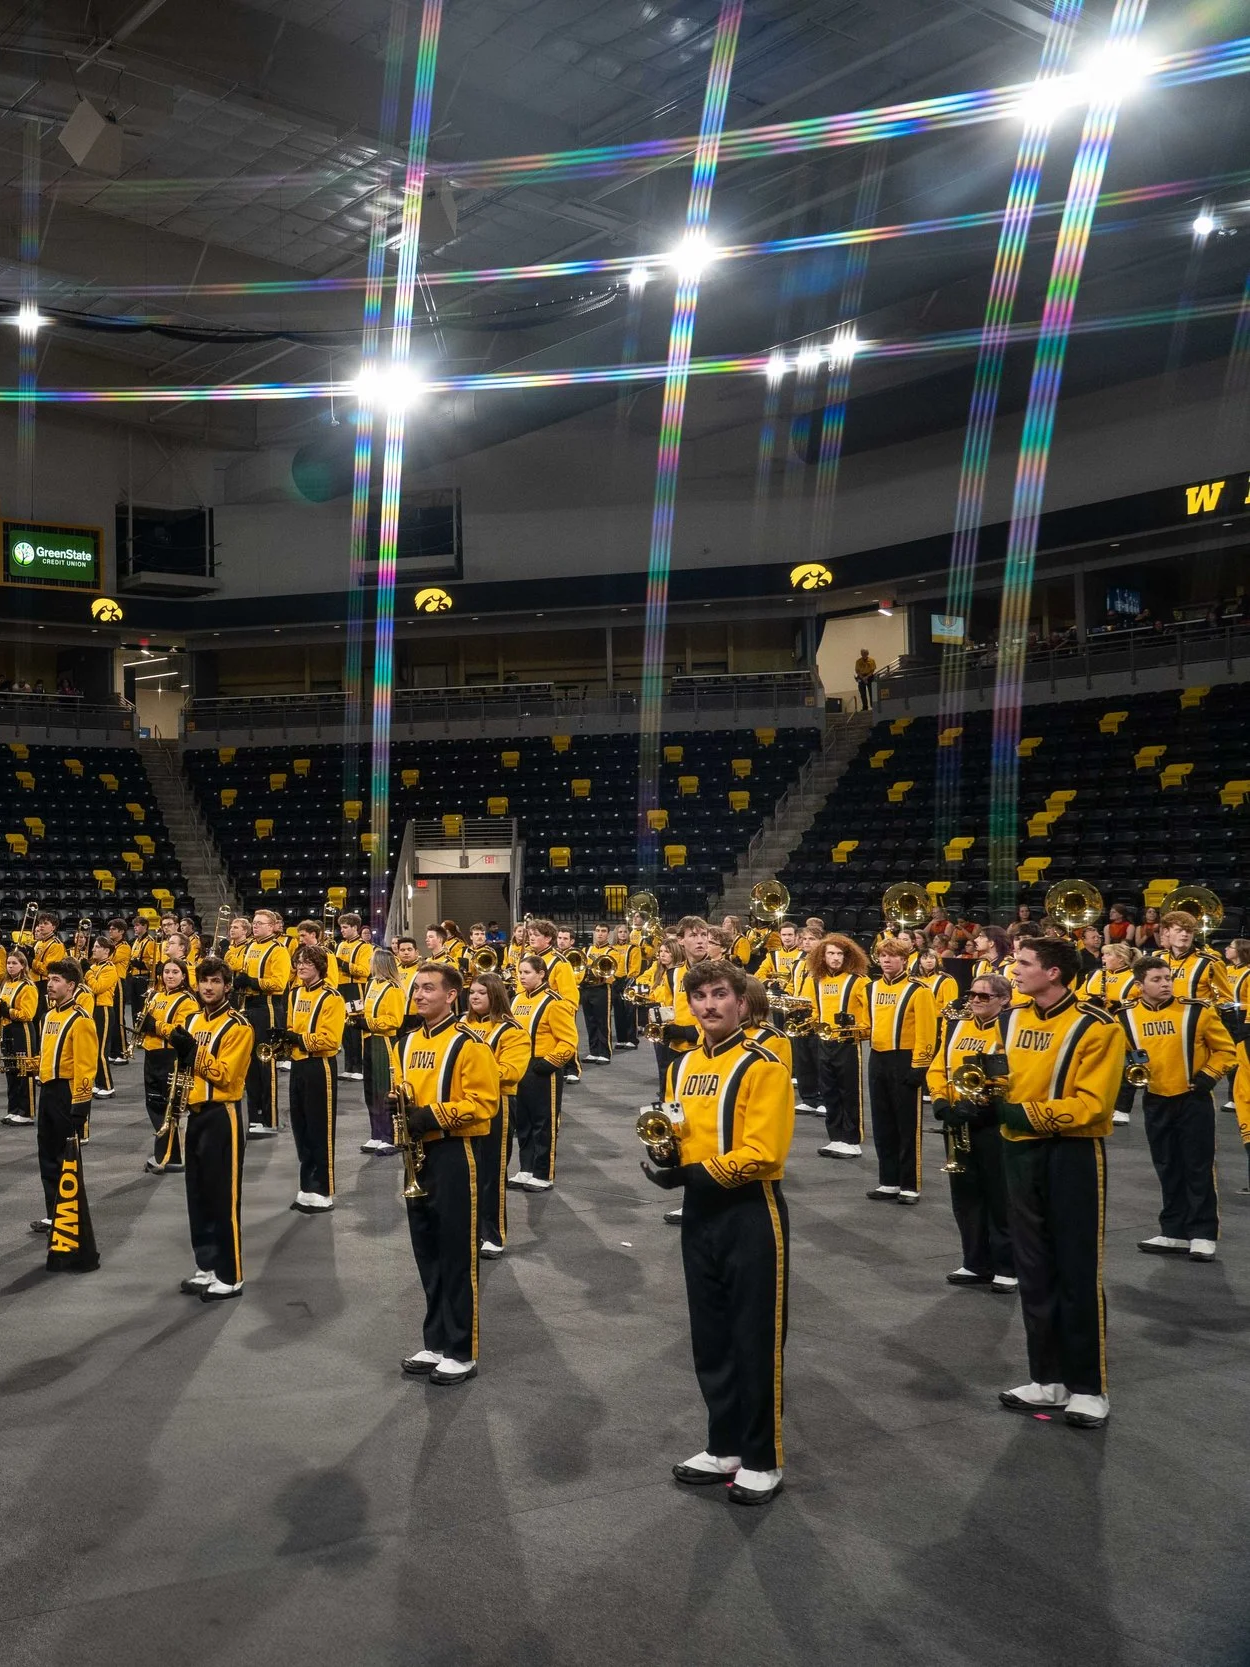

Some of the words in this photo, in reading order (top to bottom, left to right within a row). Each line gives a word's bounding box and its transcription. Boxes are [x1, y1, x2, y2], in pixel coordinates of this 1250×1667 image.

[36, 546, 92, 561] GreenState
[42, 558, 65, 566] CREDIT
[823, 983, 839, 995] IOWA
[876, 992, 897, 1005] IOWA
[1142, 1021, 1176, 1037] IOWA
[955, 1037, 987, 1052] IOWA
[1015, 1029, 1054, 1051] IOW
[409, 1051, 436, 1070] IOWA
[682, 1074, 720, 1096] IOWA
[50, 1159, 80, 1252] IOWA
